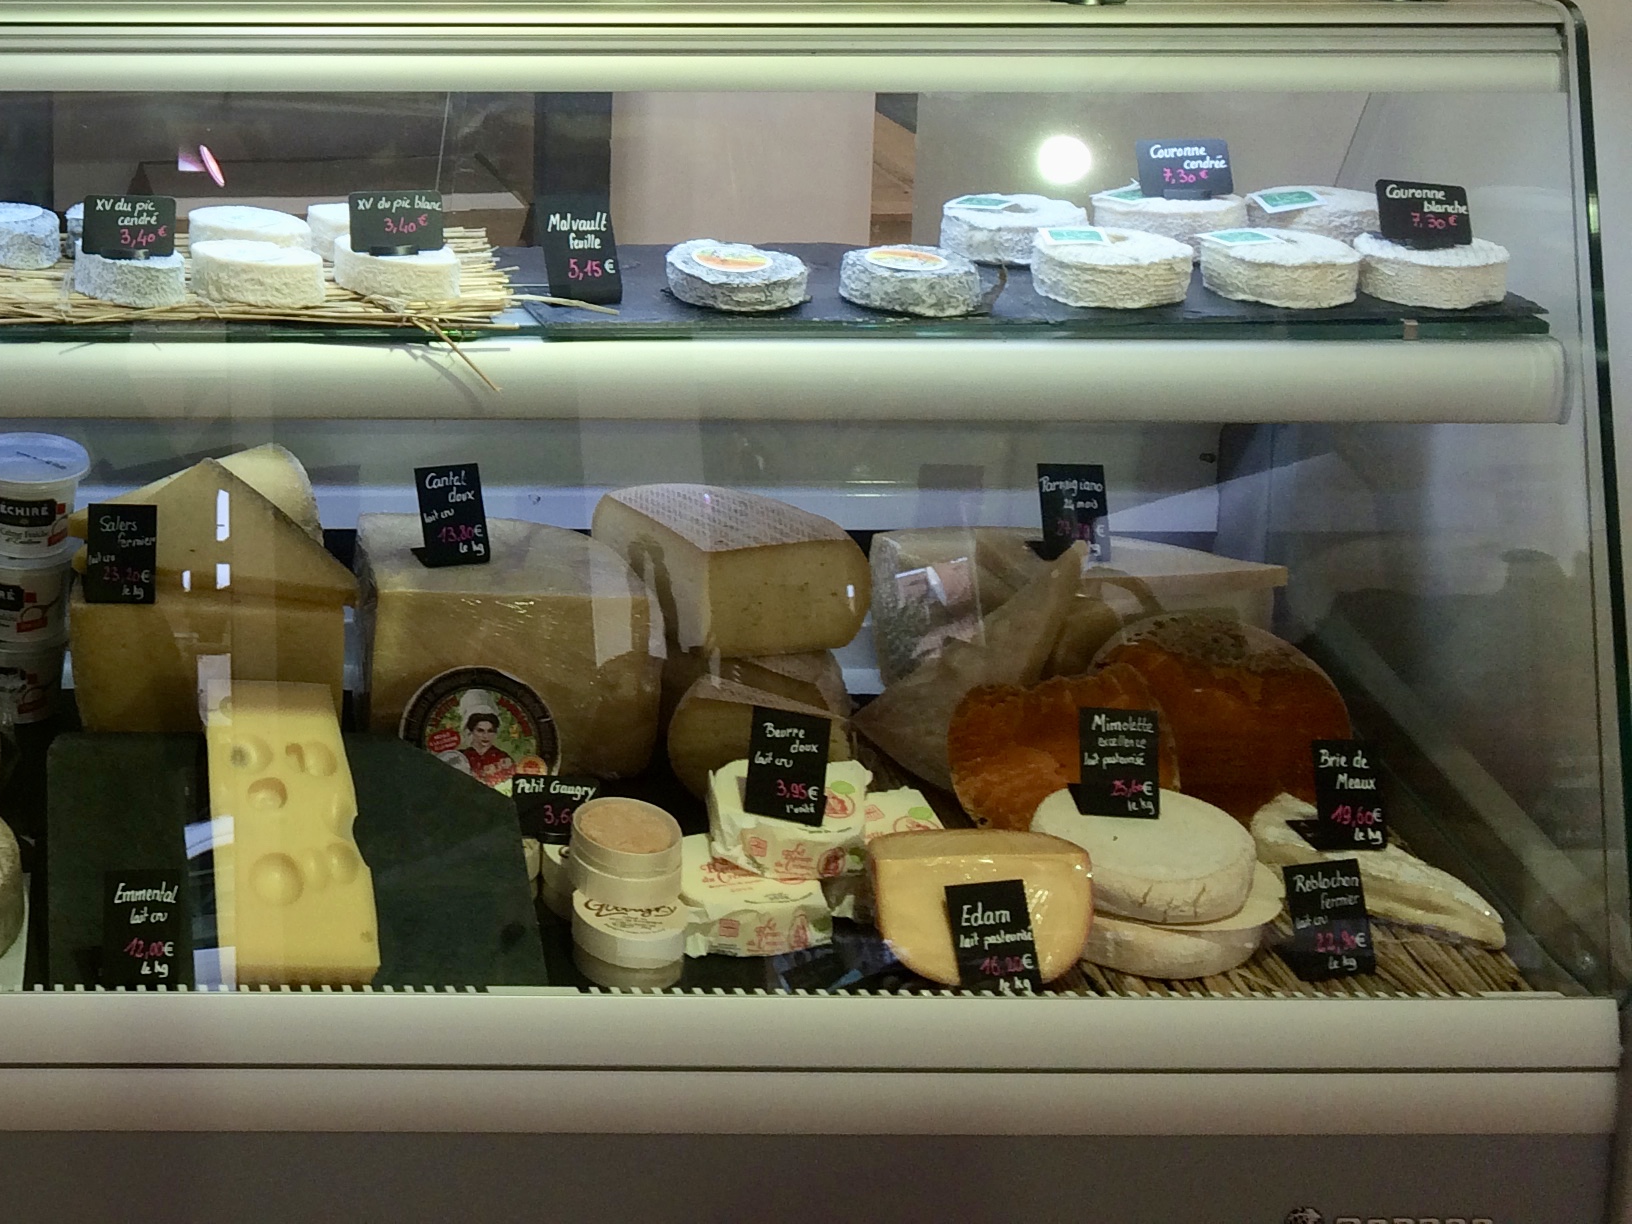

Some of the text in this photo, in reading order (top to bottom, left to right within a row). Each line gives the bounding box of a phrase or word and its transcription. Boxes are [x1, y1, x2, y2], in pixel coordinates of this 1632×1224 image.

[1149, 144, 1207, 159] Couronne
[1183, 155, 1228, 169] cendrée
[1385, 184, 1446, 200] Couronne
[95, 198, 155, 217] XV du pic
[357, 195, 442, 213] XV du pic blanc
[1423, 200, 1469, 214] blanche
[117, 212, 159, 226] cendré
[384, 217, 417, 234] 3,40
[119, 228, 156, 247] 3,40
[569, 233, 602, 250] feuille
[568, 258, 602, 280] 5,15
[425, 470, 468, 490] Cantal
[448, 486, 475, 503] doux
[0, 501, 49, 516] ÉCHIRÉ
[423, 508, 455, 523] lait cru
[99, 515, 138, 532] Salers
[117, 532, 156, 548] fermier
[459, 540, 485, 556] le kg
[763, 722, 806, 738] Beurre
[1091, 714, 1155, 733] Mimolette
[790, 740, 819, 753] doux
[754, 751, 793, 768] lait cru
[1319, 749, 1370, 769] Brie de
[1336, 773, 1376, 790] Meaux
[515, 779, 597, 802] Petit Gaugry
[1128, 798, 1155, 815] le kg
[1354, 828, 1383, 845] le kg
[1292, 869, 1360, 893] Reblochon
[114, 881, 179, 904] Emmental
[1321, 892, 1360, 910] fermier
[129, 906, 168, 925] lait cru
[961, 901, 1011, 927] Edam
[959, 932, 980, 948] lait
[140, 960, 169, 978] le kg
[1329, 956, 1358, 971] le kg
